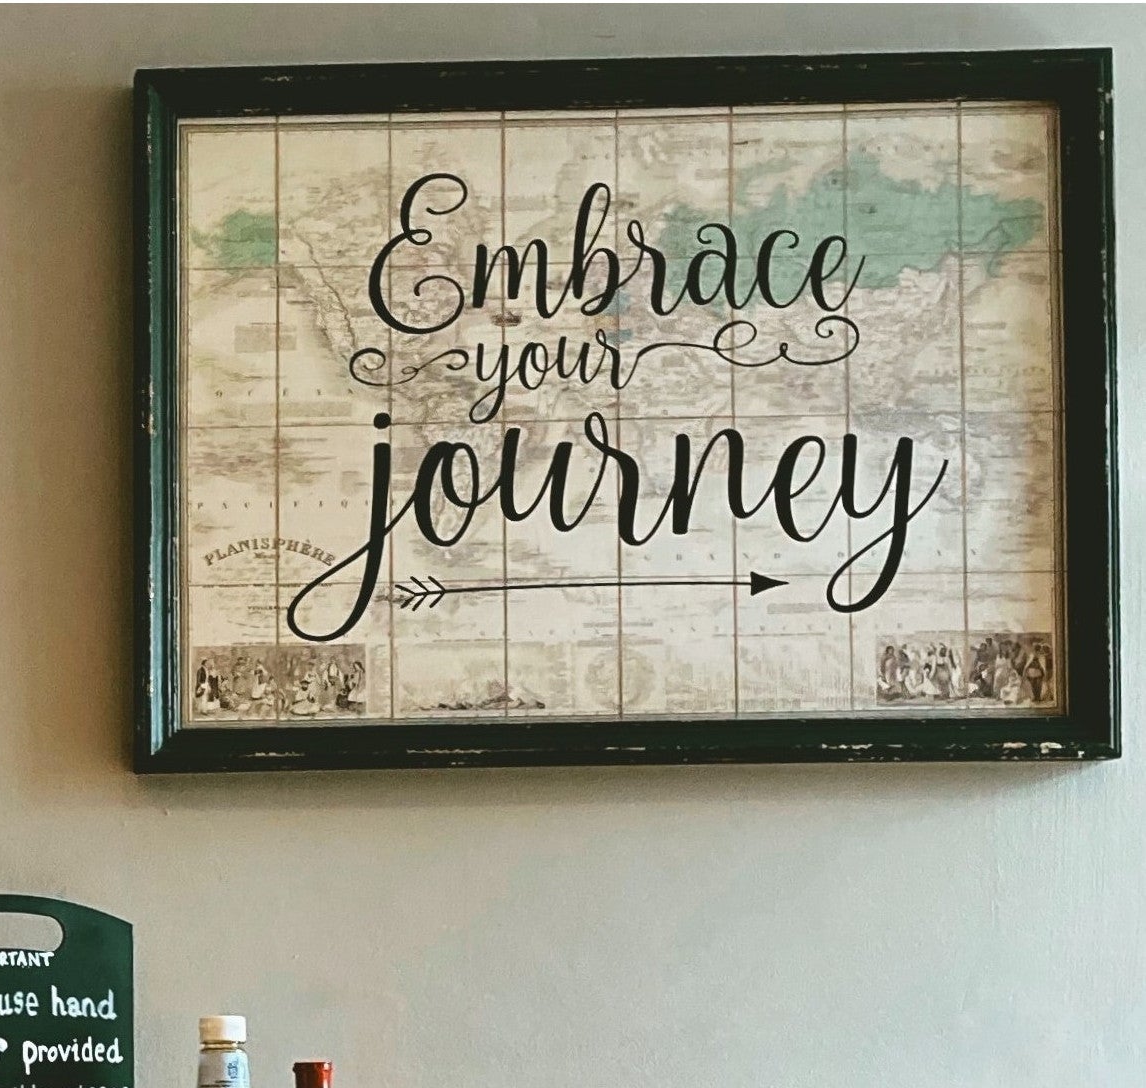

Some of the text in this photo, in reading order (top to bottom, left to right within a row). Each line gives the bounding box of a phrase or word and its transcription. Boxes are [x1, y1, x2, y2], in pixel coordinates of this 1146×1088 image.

[368, 173, 866, 334] Embrace
[469, 329, 641, 424] your
[203, 538, 337, 567] PLANISPHÈRE
[287, 412, 949, 642] journey
[51, 985, 117, 1020] hand
[23, 1036, 124, 1076] provided
